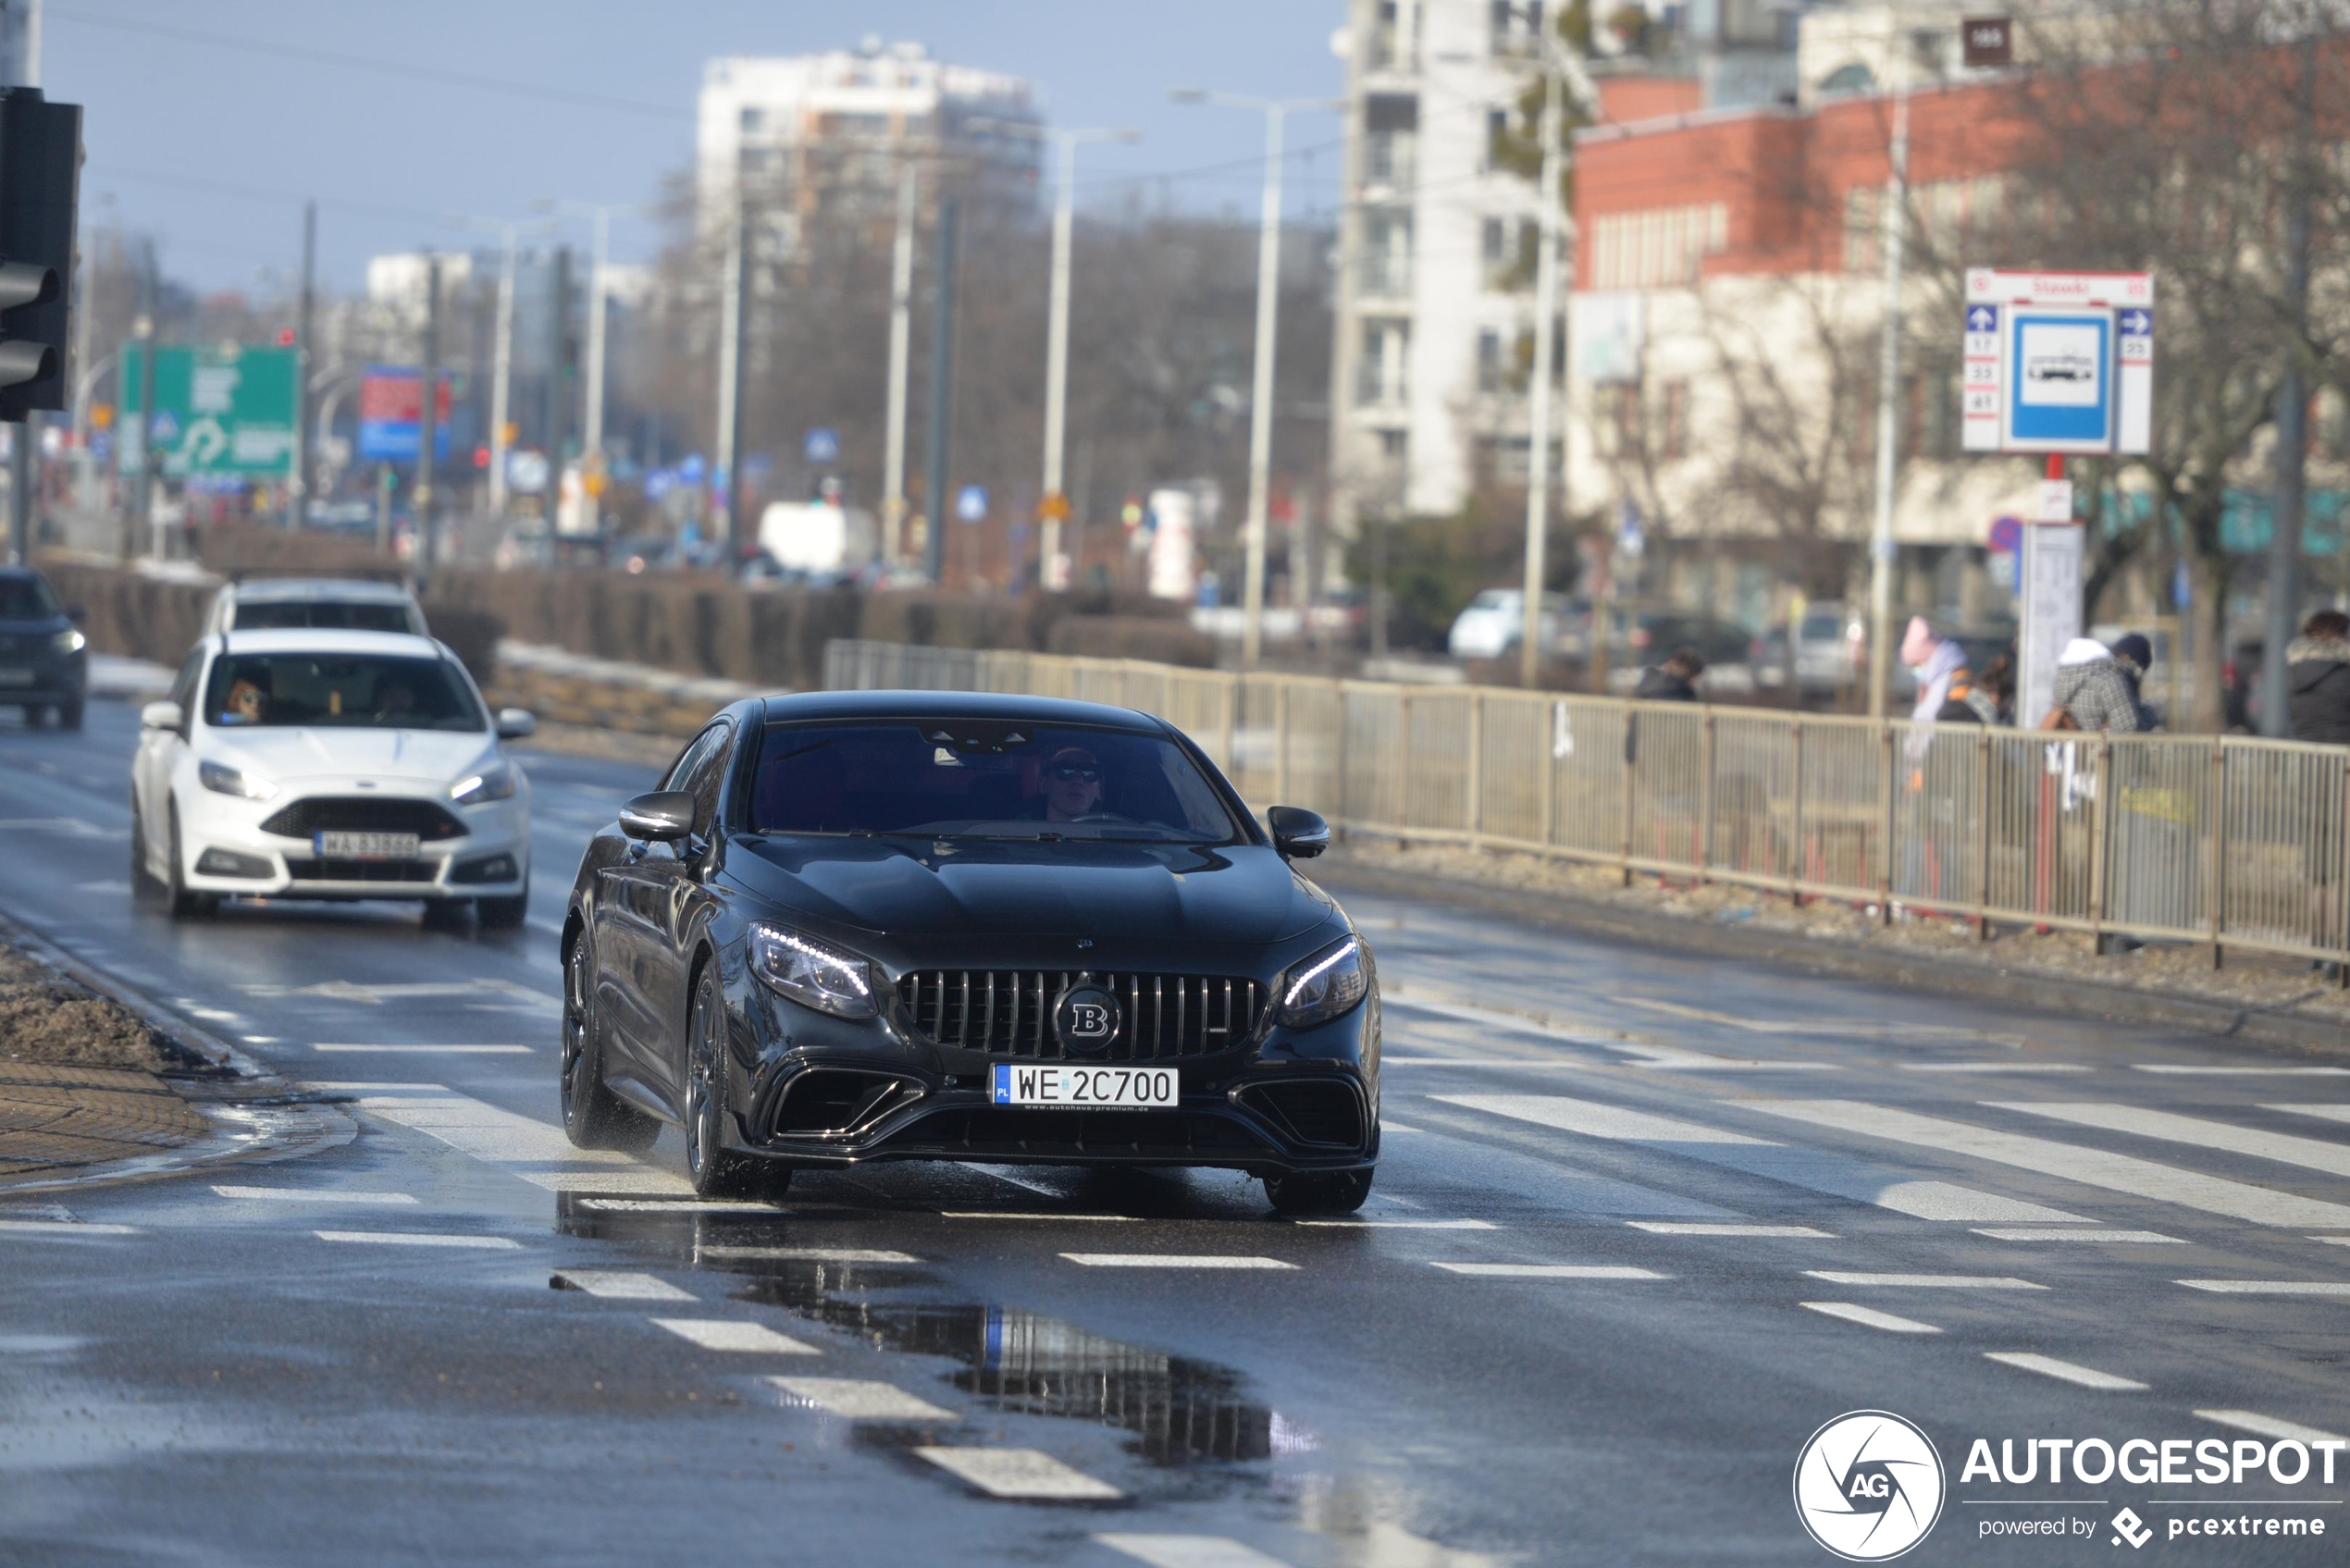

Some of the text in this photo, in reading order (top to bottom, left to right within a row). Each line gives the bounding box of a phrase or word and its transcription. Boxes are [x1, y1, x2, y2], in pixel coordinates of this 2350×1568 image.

[1072, 1004, 1107, 1036] B
[997, 1088, 1008, 1097] PL
[1019, 1069, 1170, 1102] WE 2C700
[1024, 1104, 1149, 1113] www.autohaus-premium.de
